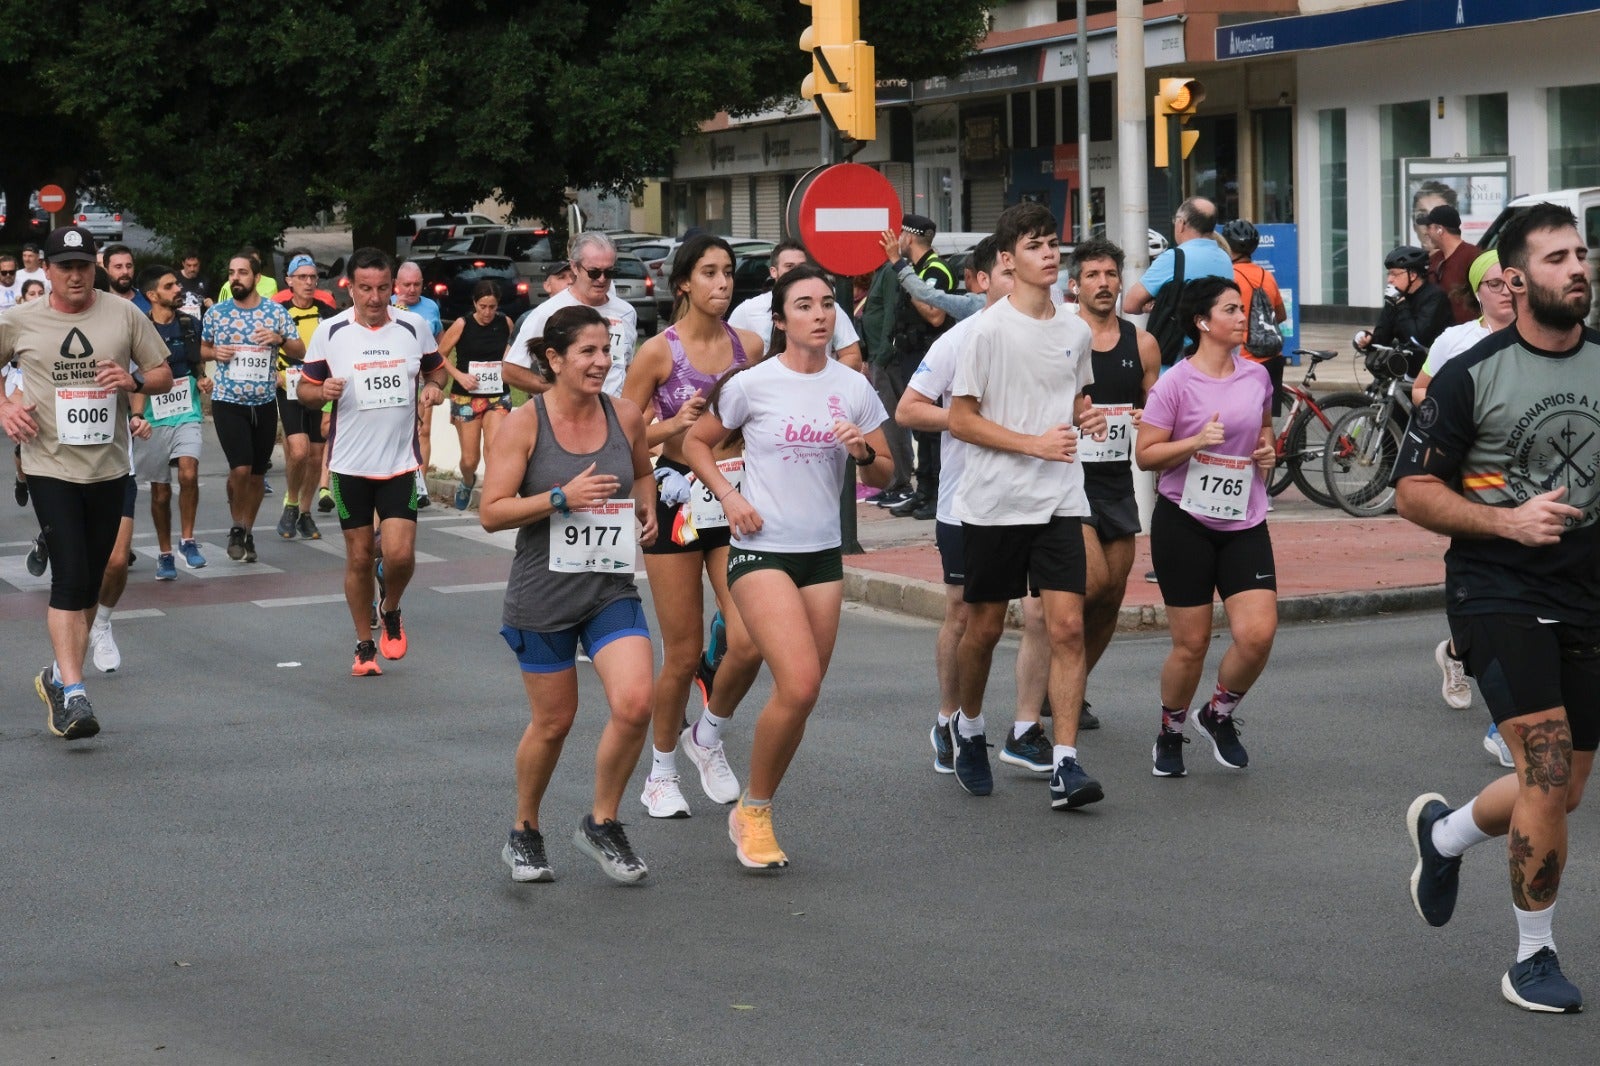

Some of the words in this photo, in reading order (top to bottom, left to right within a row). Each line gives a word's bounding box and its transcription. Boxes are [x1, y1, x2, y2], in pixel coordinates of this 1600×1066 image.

[876, 77, 907, 88] zome
[1259, 235, 1275, 244] ADA
[609, 333, 621, 346] 77
[54, 361, 86, 371] Sierra
[89, 360, 97, 368] d
[234, 357, 268, 369] 11935
[52, 372, 68, 381] las
[364, 375, 401, 390] 1586
[155, 389, 188, 406] 13007
[67, 408, 108, 424] 6006
[1077, 424, 1126, 440] 151
[1504, 392, 1576, 458] LEGIONARIOS
[1579, 394, 1589, 408] A
[785, 423, 836, 443] blue
[1200, 474, 1243, 497] 1765
[564, 525, 621, 546] 9177
